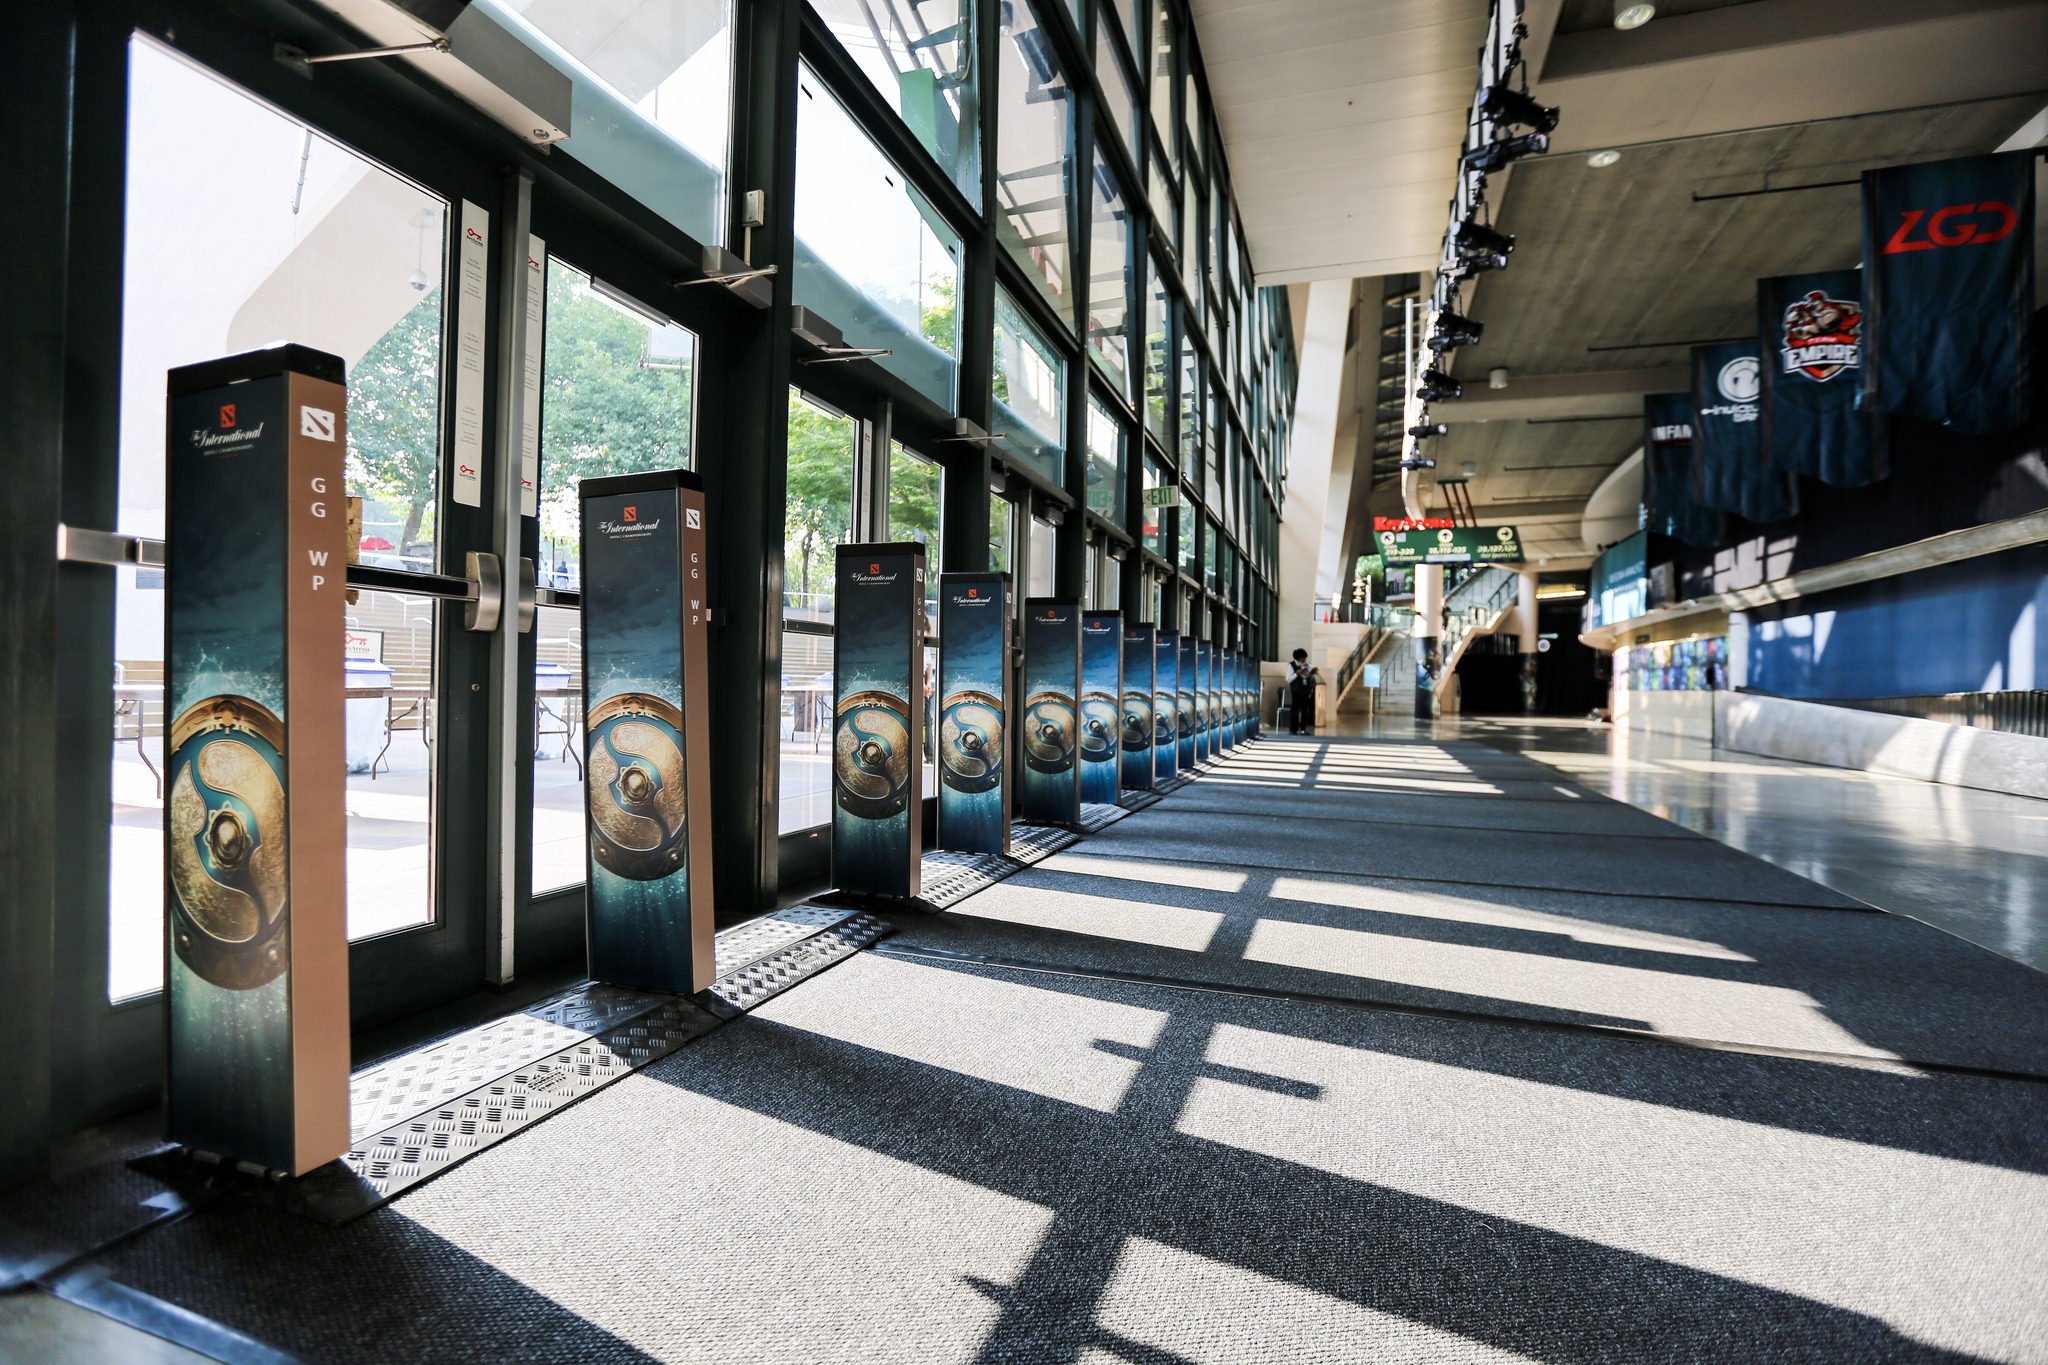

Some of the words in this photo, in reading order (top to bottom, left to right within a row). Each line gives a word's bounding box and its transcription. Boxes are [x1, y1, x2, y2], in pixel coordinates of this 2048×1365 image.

[1883, 201, 2017, 255] LGD
[1787, 344, 1858, 369] EMPIRE
[195, 422, 264, 449] International
[310, 478, 326, 518] GG
[1151, 487, 1172, 505] EXIT
[602, 518, 660, 534] International
[308, 550, 328, 590] WP
[853, 573, 898, 582] International
[955, 596, 992, 604] International
